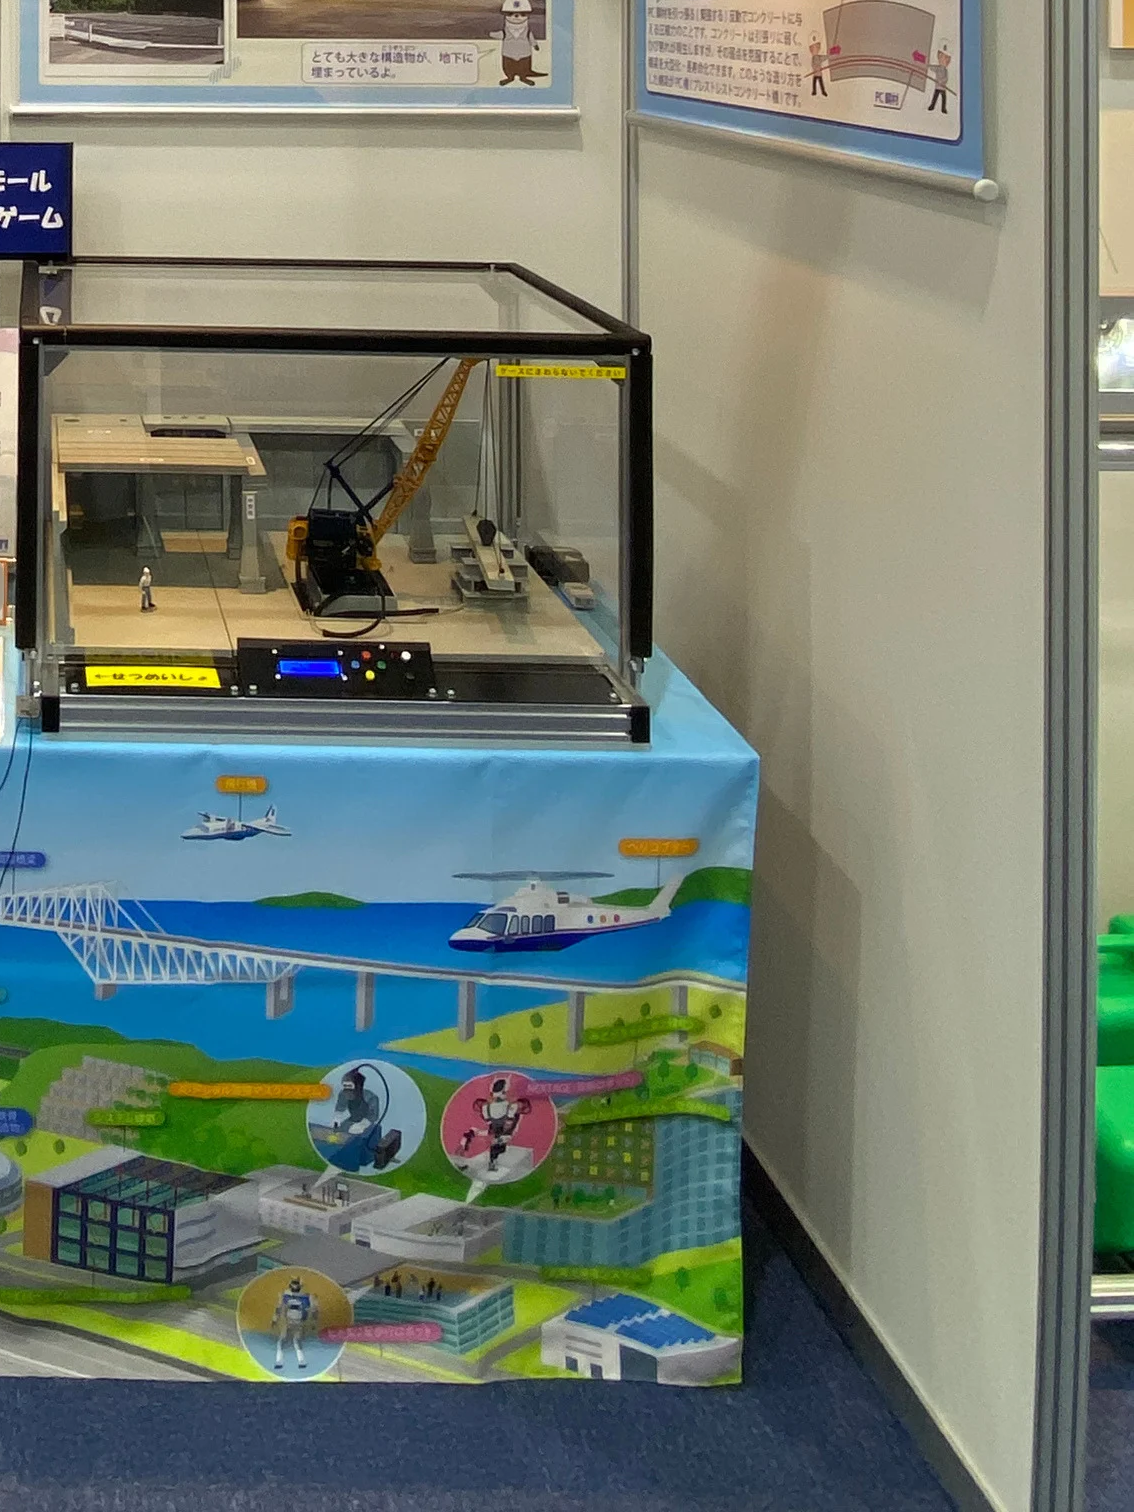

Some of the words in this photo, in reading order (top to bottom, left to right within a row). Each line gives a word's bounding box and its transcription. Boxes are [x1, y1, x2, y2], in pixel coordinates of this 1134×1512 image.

[311, 52, 473, 64] とても大きな構造物が、地下に
[311, 67, 396, 79] 埋まっているよ。
